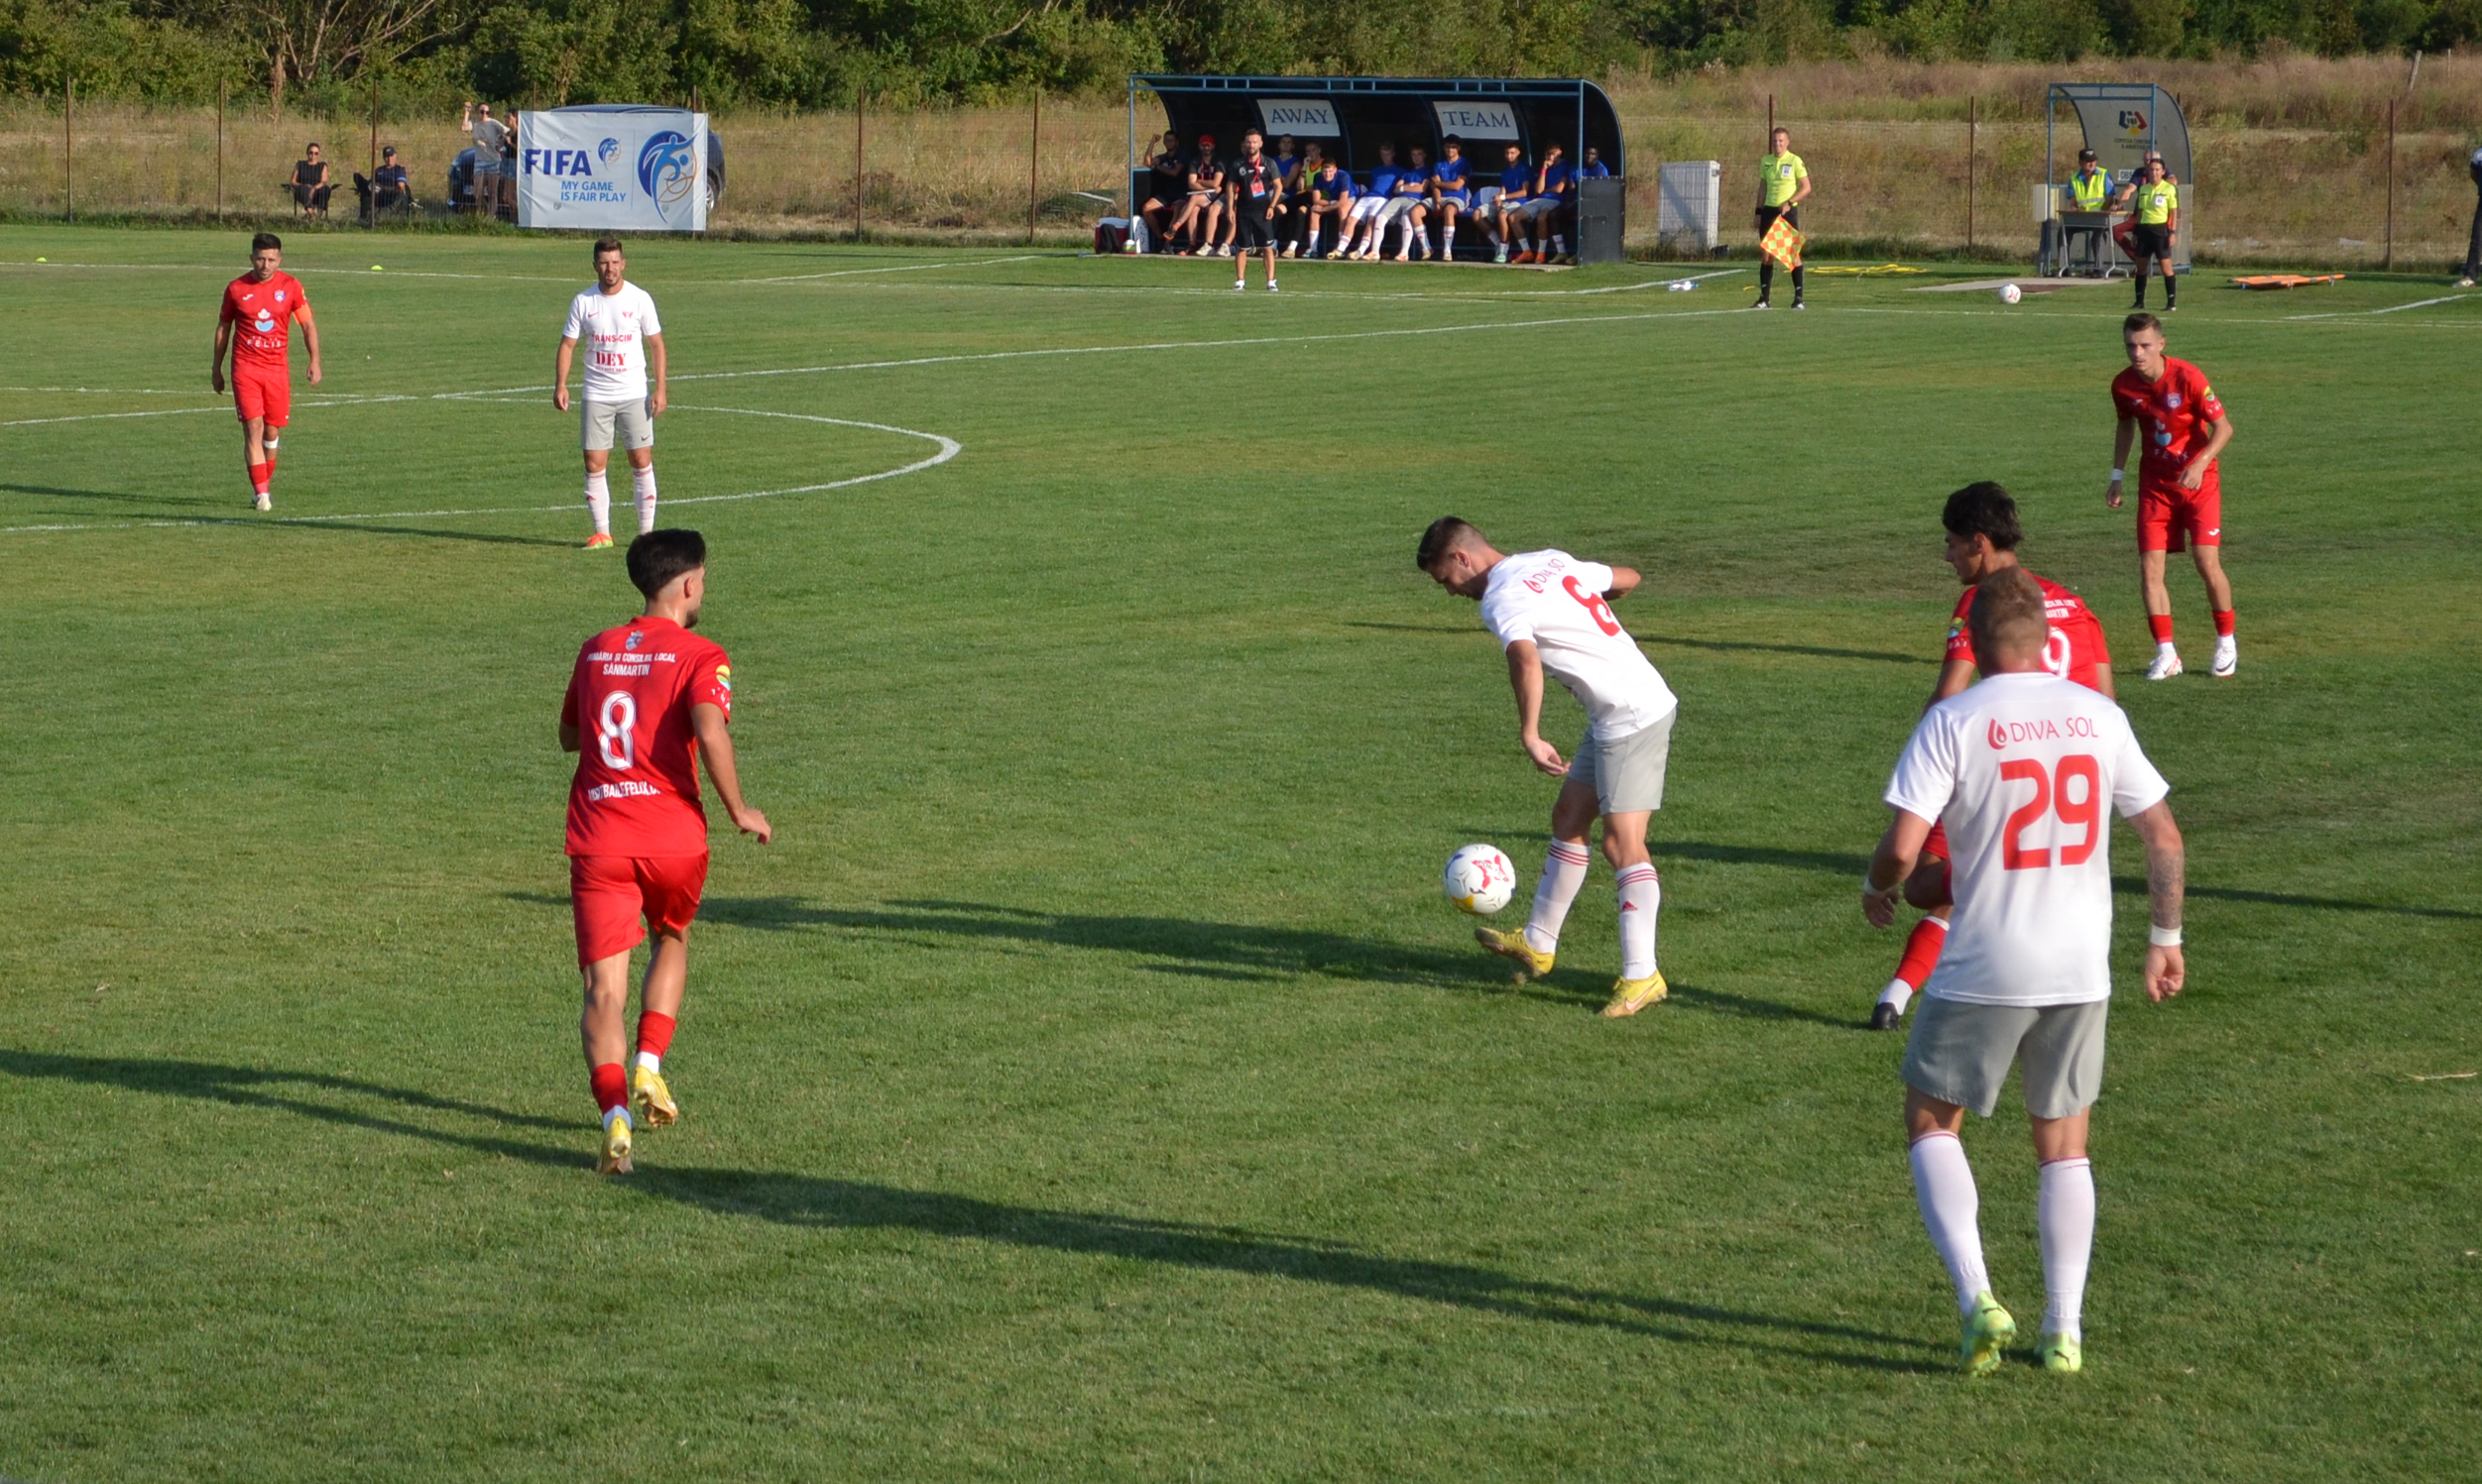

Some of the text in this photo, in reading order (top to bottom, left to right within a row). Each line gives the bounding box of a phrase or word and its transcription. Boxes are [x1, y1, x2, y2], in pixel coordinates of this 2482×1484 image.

[1270, 108, 1511, 129] AWAY TEAM
[525, 148, 593, 176] FIFA
[561, 180, 614, 191] MY GAME
[560, 191, 627, 202] IS FAIR PLAY
[596, 351, 627, 367] DEY
[654, 652, 676, 663] LOCAL
[598, 690, 637, 771] 8
[2010, 717, 2099, 743] DIVA SOL
[1999, 753, 2101, 871] 29
